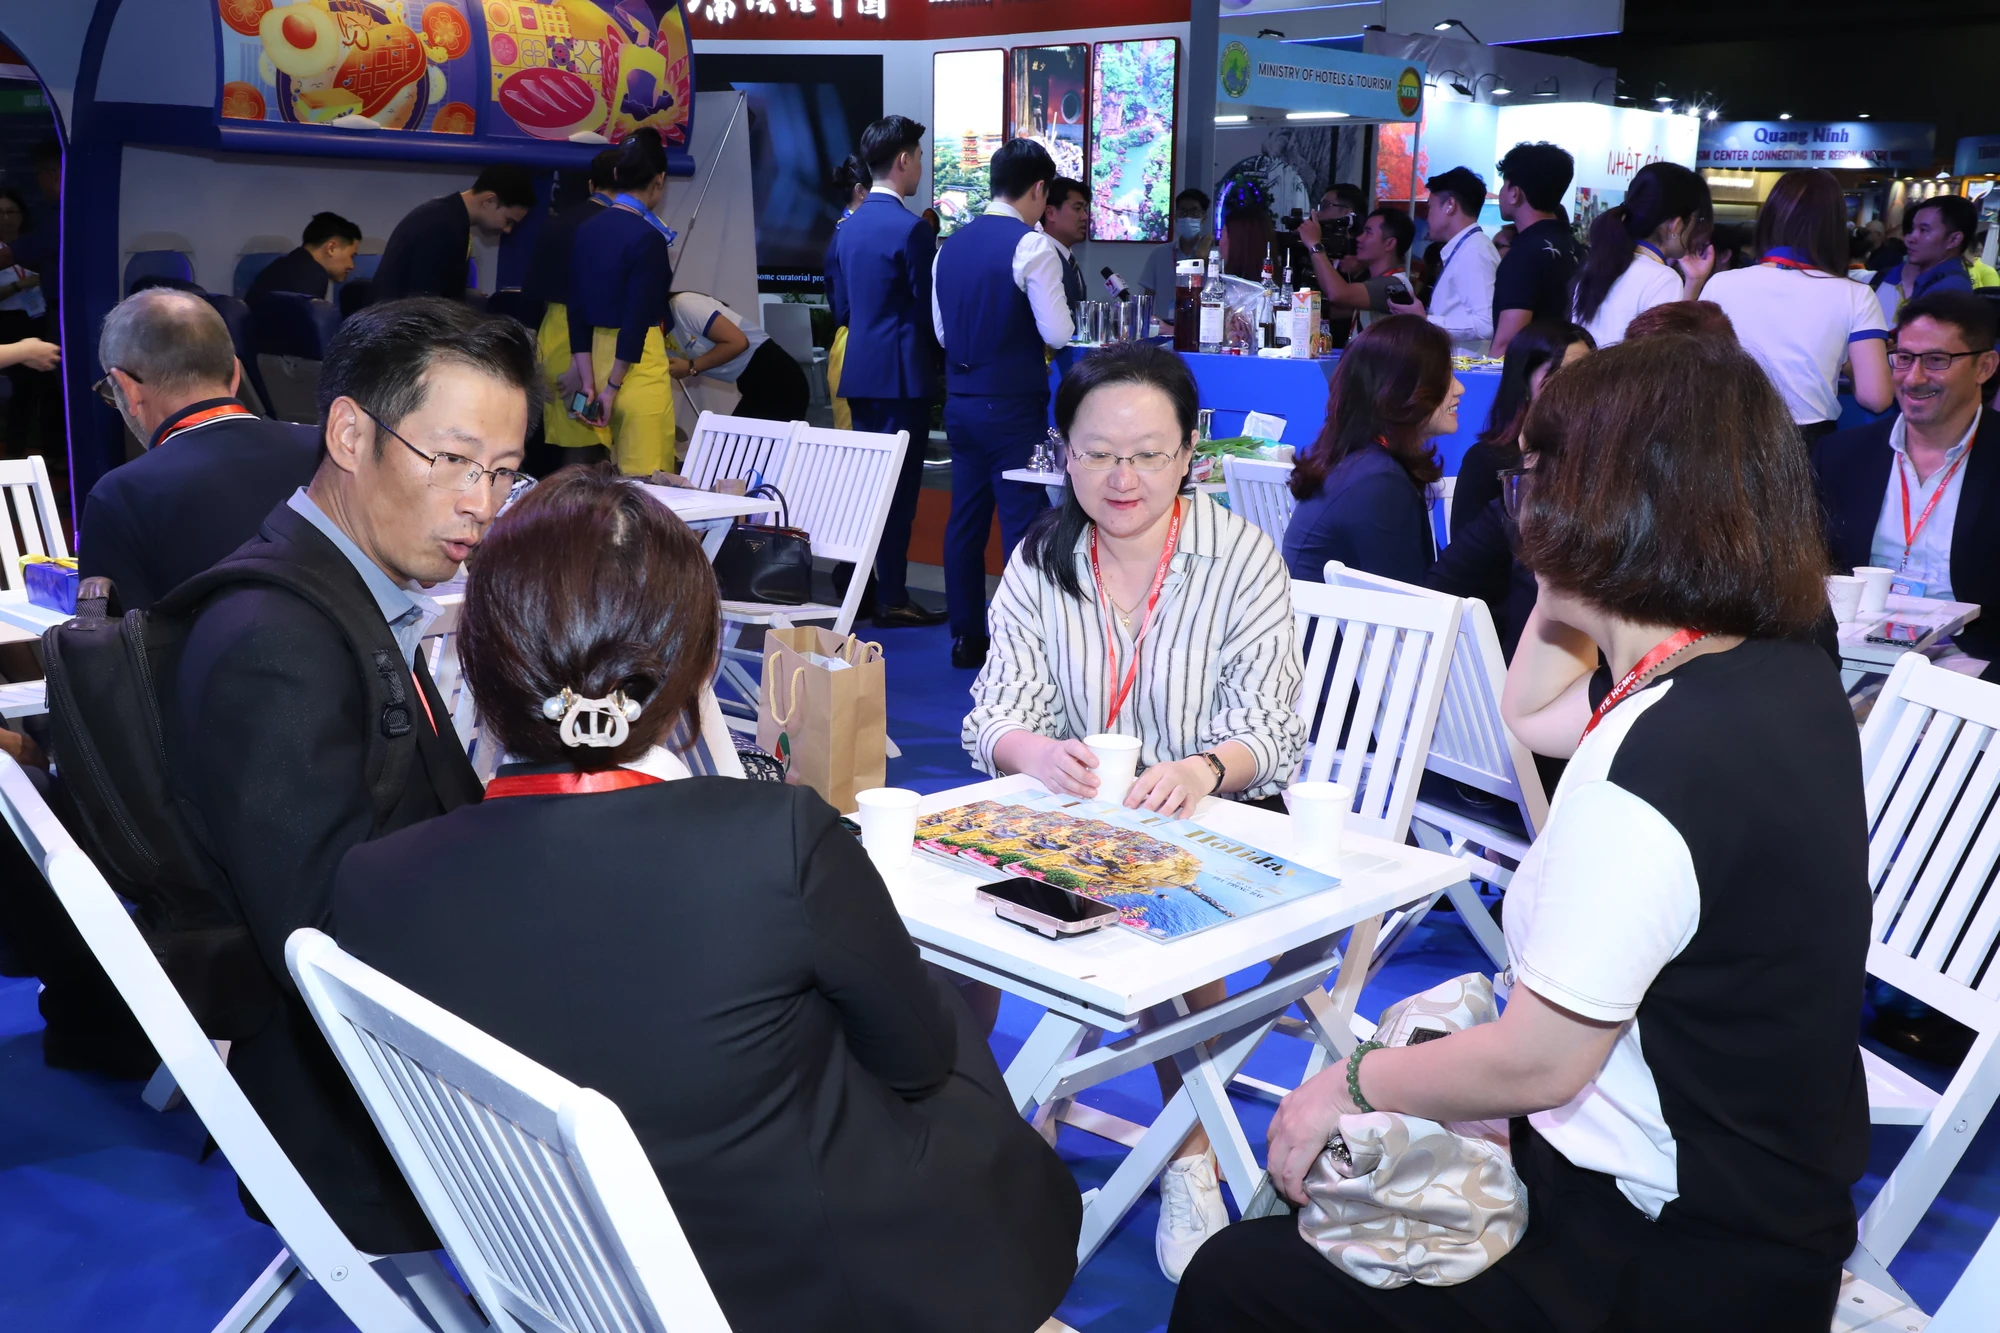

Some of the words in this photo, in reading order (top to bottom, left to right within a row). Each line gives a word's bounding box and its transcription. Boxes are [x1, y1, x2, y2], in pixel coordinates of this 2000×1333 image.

[1258, 62, 1301, 80] MINISTRY
[1302, 68, 1314, 81] OF
[1315, 70, 1347, 86] HOTELS
[1347, 74, 1354, 86] &
[1356, 75, 1392, 91] TOURISM
[1401, 86, 1418, 97] MTM
[1813, 127, 1849, 143] Ninh
[1713, 150, 1749, 161] CENTER
[1752, 150, 1808, 161] CONNECTING
[1811, 150, 1826, 160] THE
[1829, 150, 1858, 160] REGION
[776, 273, 810, 281] curatorial
[812, 275, 825, 284] pro
[1171, 516, 1179, 536] HCMC
[1168, 536, 1176, 548] ITE
[1158, 562, 1168, 582] HCMC
[1599, 697, 1612, 713] ITE
[1611, 671, 1637, 698] HCMC
[1184, 829, 1296, 877] Holiday
